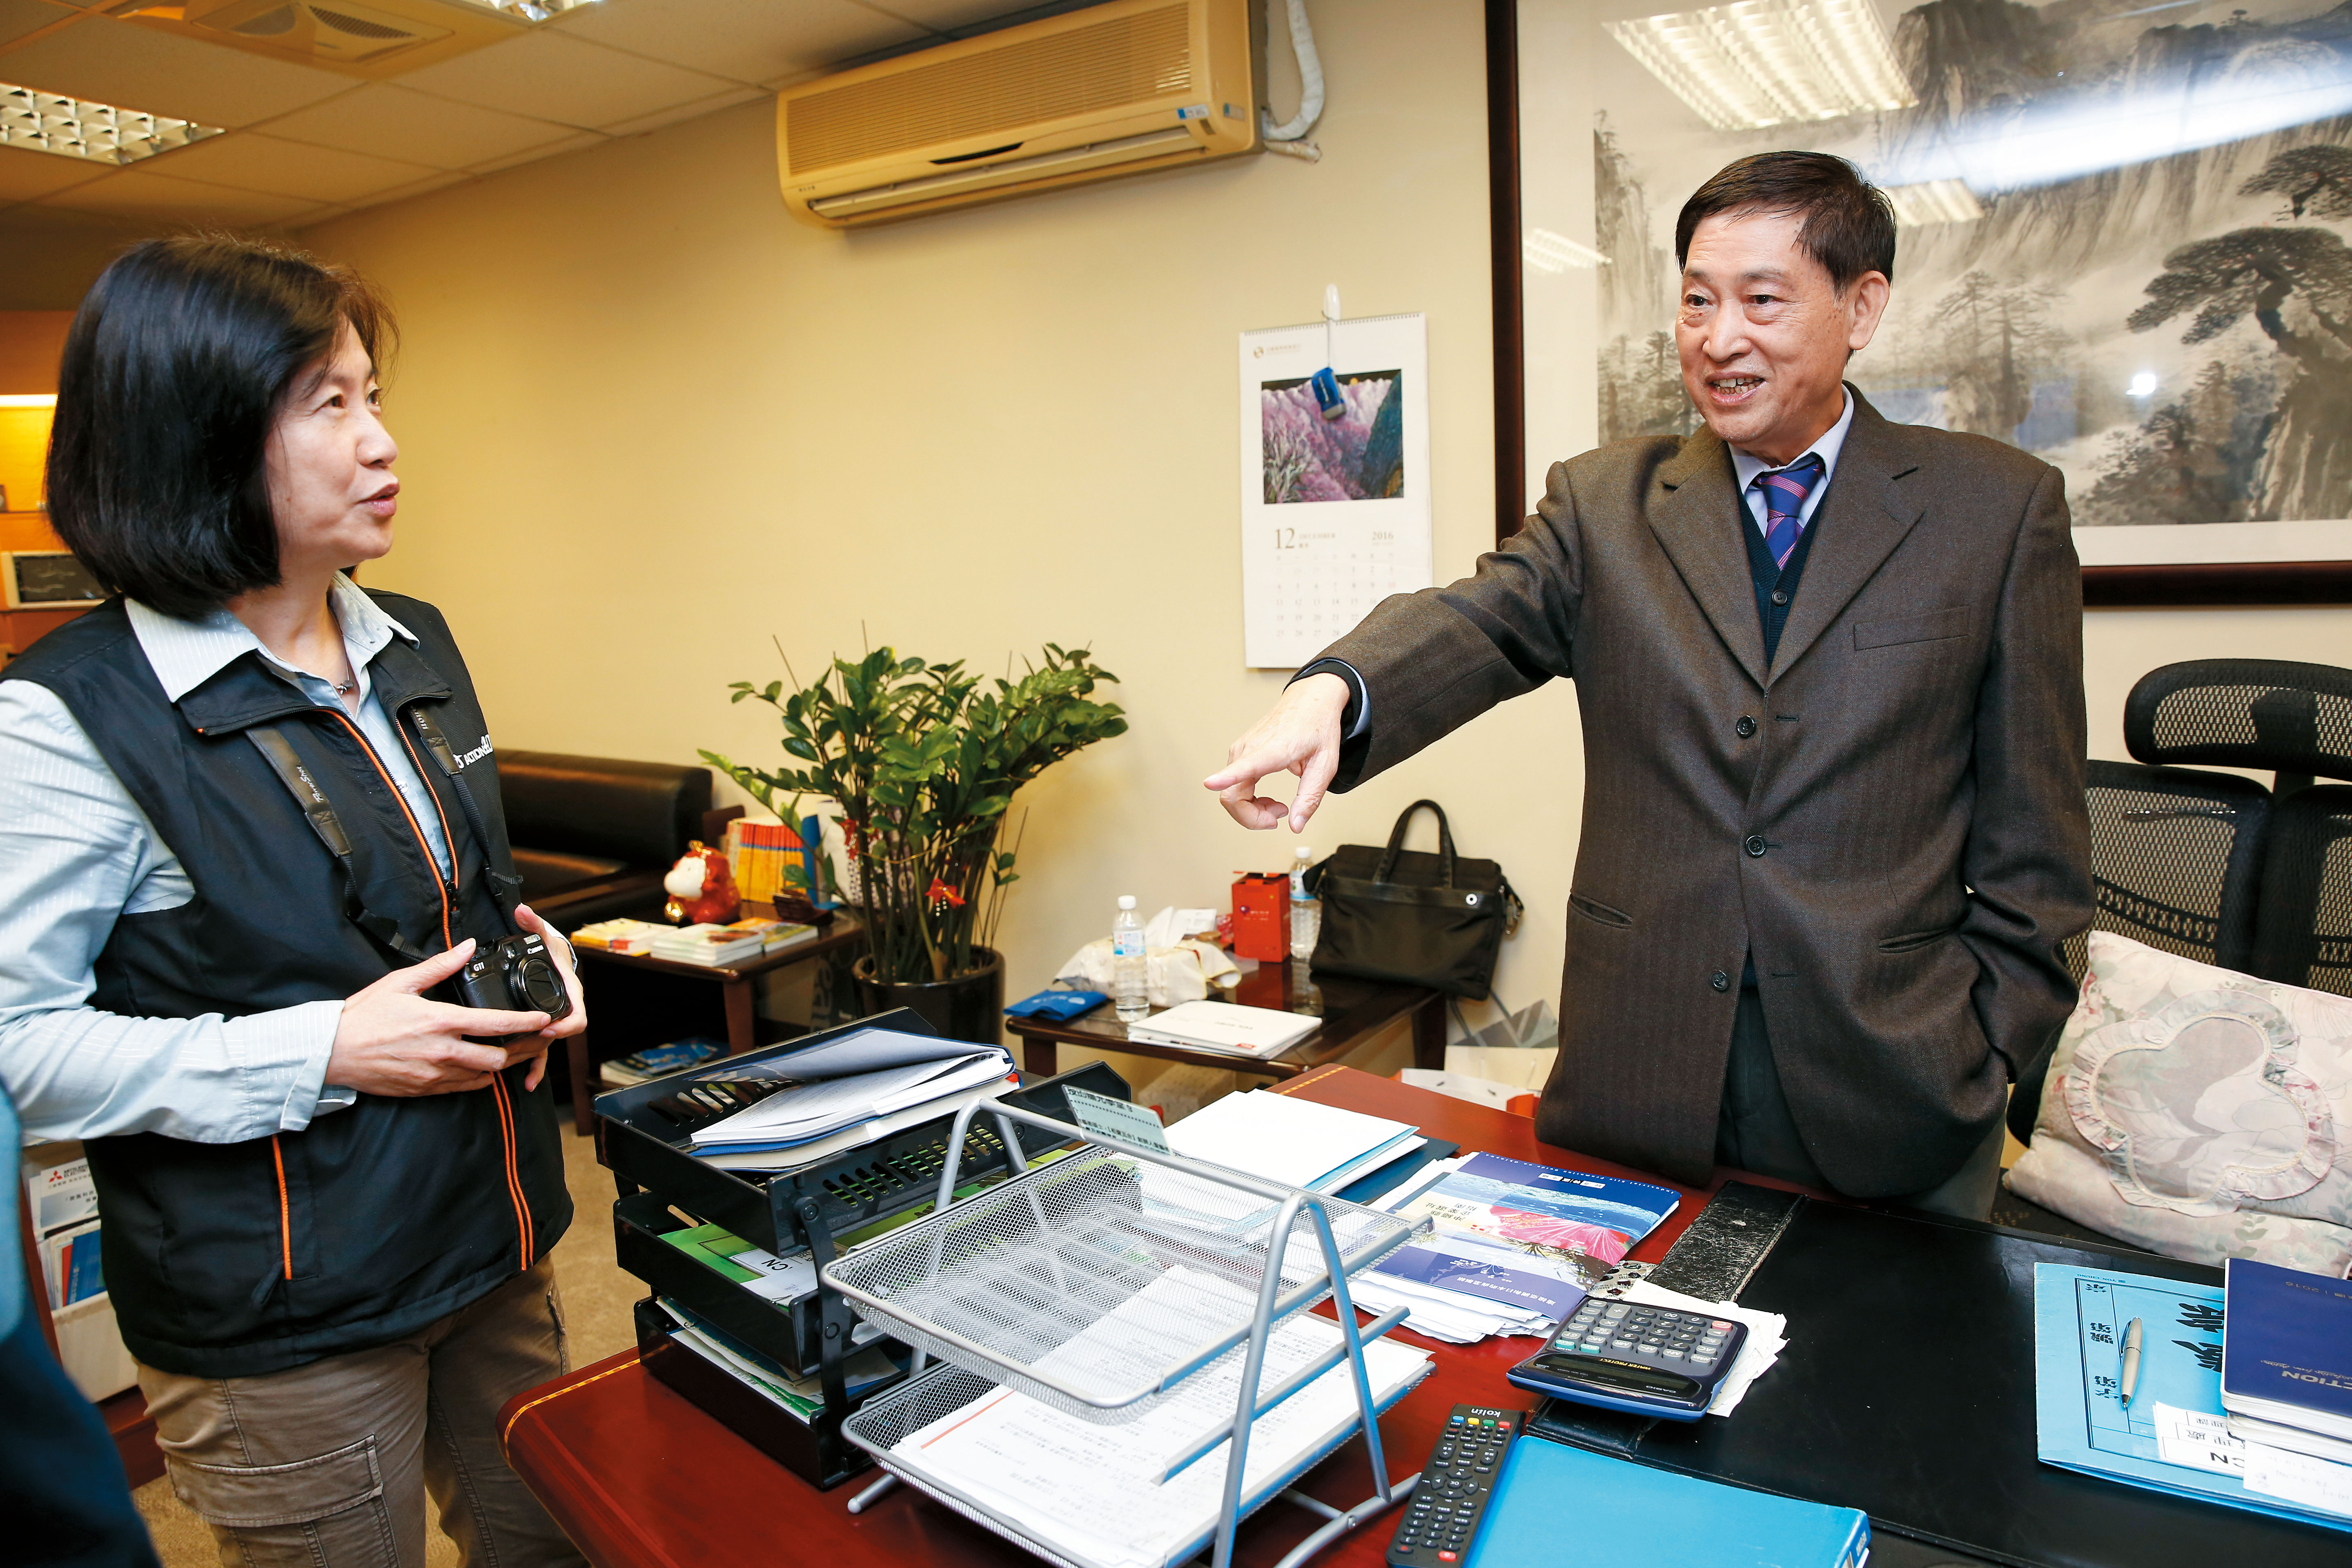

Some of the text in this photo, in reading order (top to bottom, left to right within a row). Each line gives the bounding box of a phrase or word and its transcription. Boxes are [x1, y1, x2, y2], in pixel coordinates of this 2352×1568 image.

[1275, 528, 1295, 549] 12
[1372, 531, 1394, 541] 2016
[412, 709, 428, 729] non
[527, 944, 544, 954] Canon
[473, 961, 485, 972] G11
[1630, 1181, 1674, 1195] Industrial
[761, 1259, 793, 1270] CN
[2085, 1284, 2107, 1293] 宗
[2285, 1281, 2319, 1292] 2016
[1599, 1358, 1628, 1366] PROTECT
[1470, 1408, 1501, 1418] kolin
